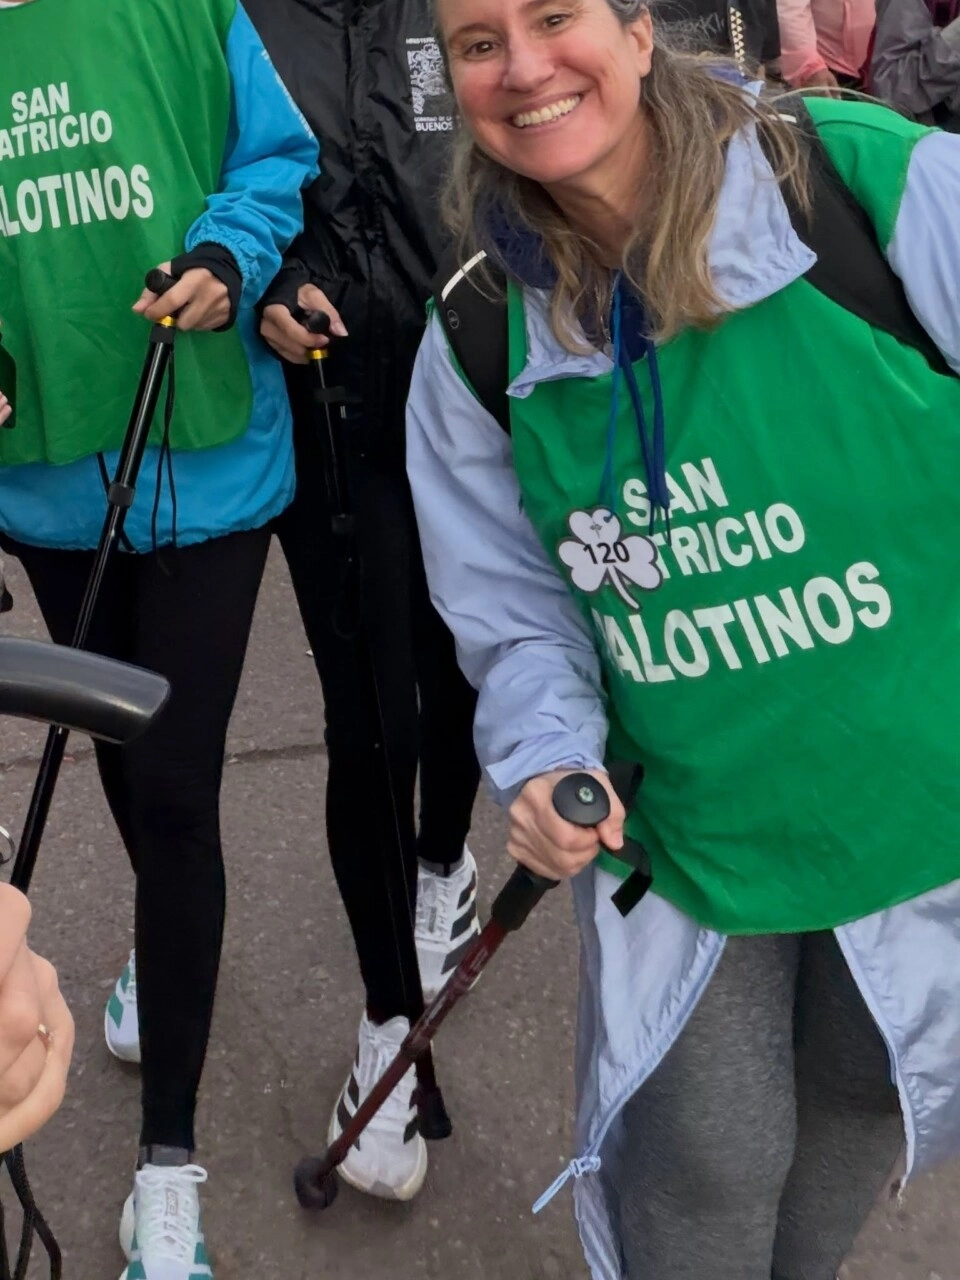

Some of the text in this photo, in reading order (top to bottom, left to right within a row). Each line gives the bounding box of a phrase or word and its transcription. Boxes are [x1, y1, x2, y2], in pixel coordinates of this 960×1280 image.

[11, 82, 70, 123] SAN
[623, 457, 729, 526] SAN
[583, 541, 630, 565] 120
[604, 503, 806, 585] TRICIO
